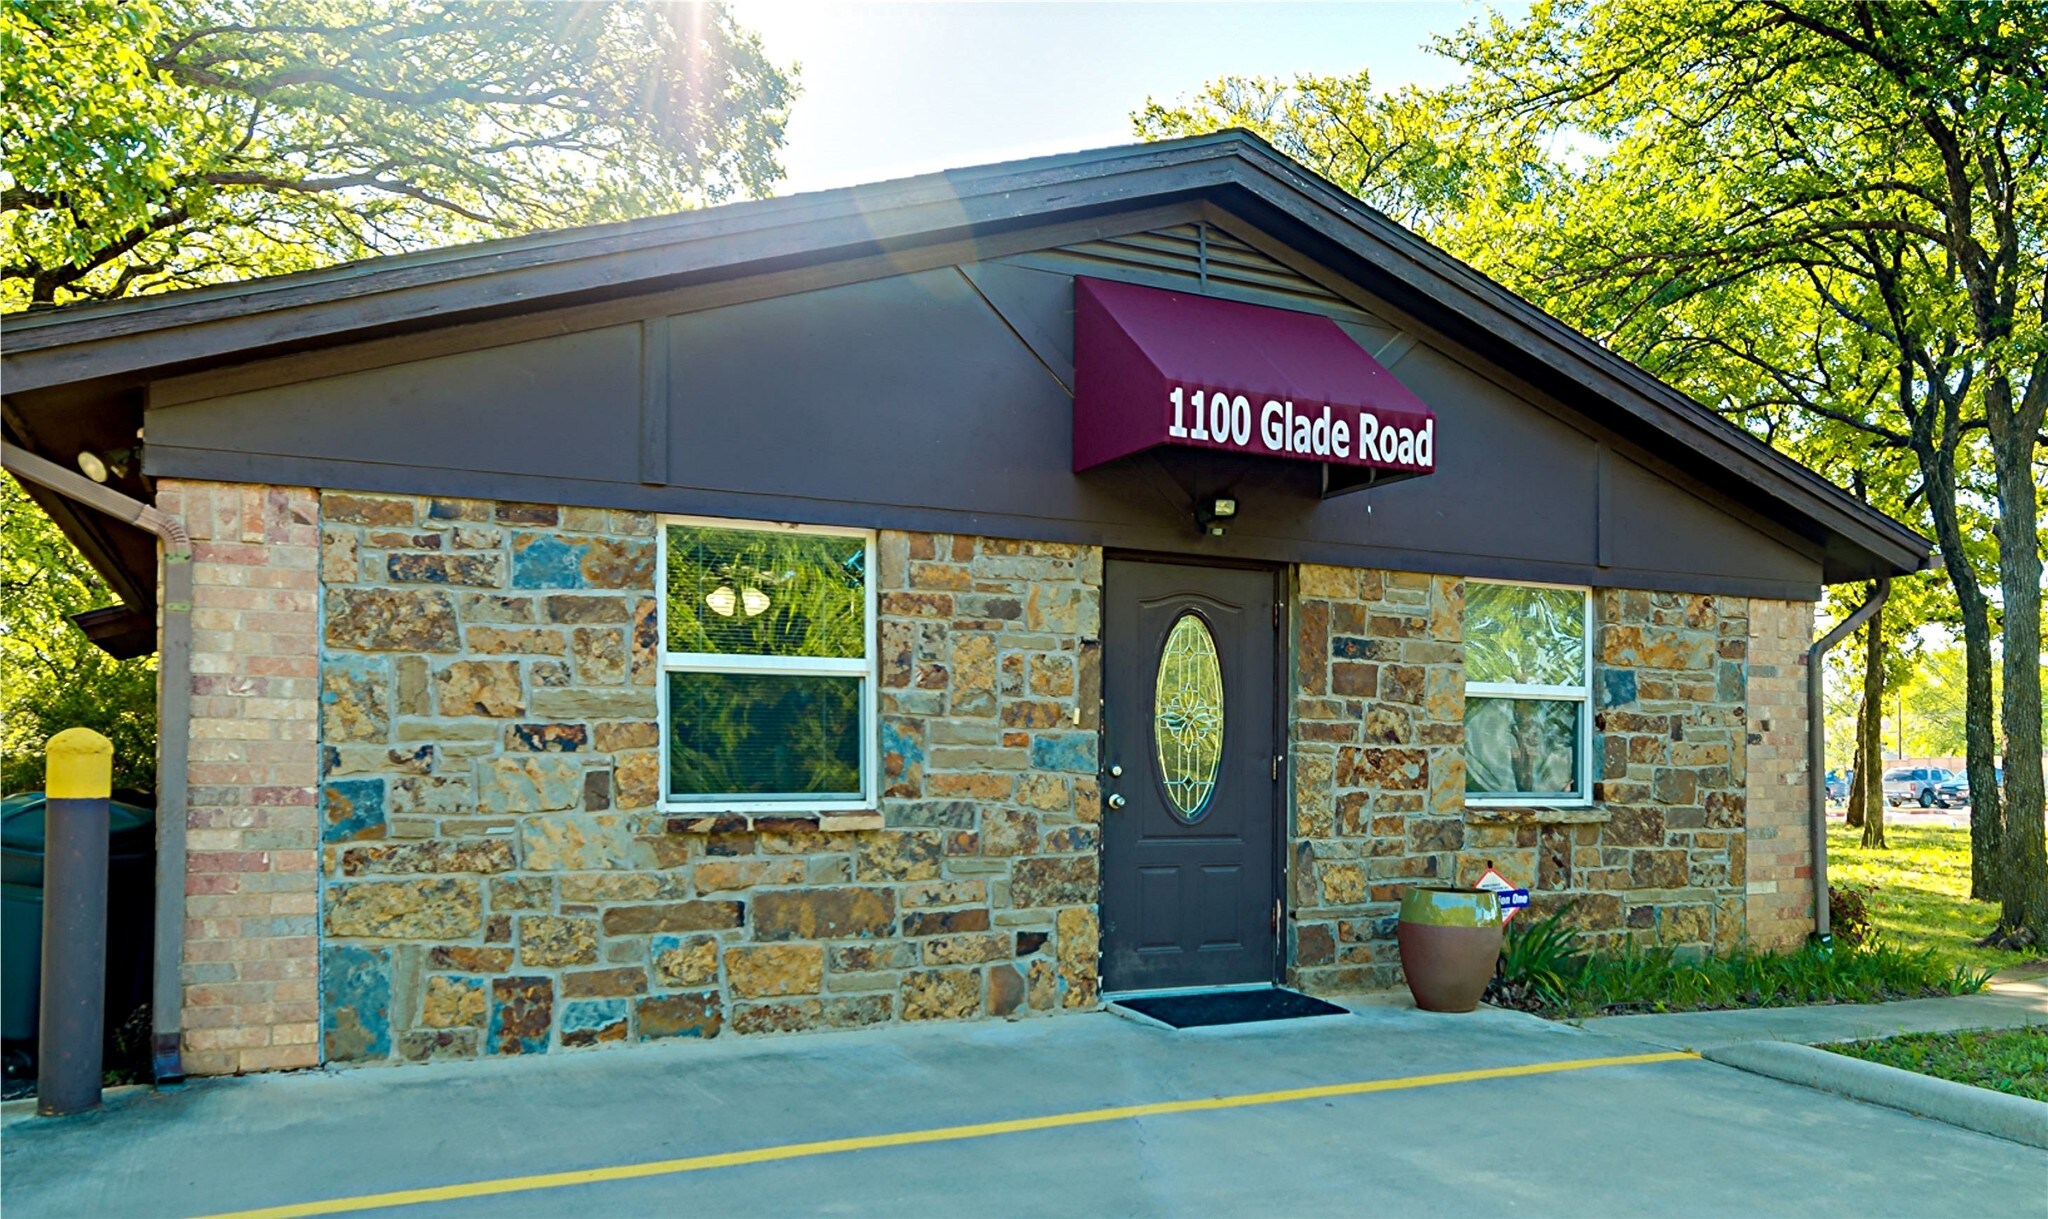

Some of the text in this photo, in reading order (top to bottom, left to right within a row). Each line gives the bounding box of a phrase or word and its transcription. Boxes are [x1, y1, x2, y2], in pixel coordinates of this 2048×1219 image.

[1169, 387, 1434, 467] 1100 Glade Road
[1512, 893, 1528, 904] One
